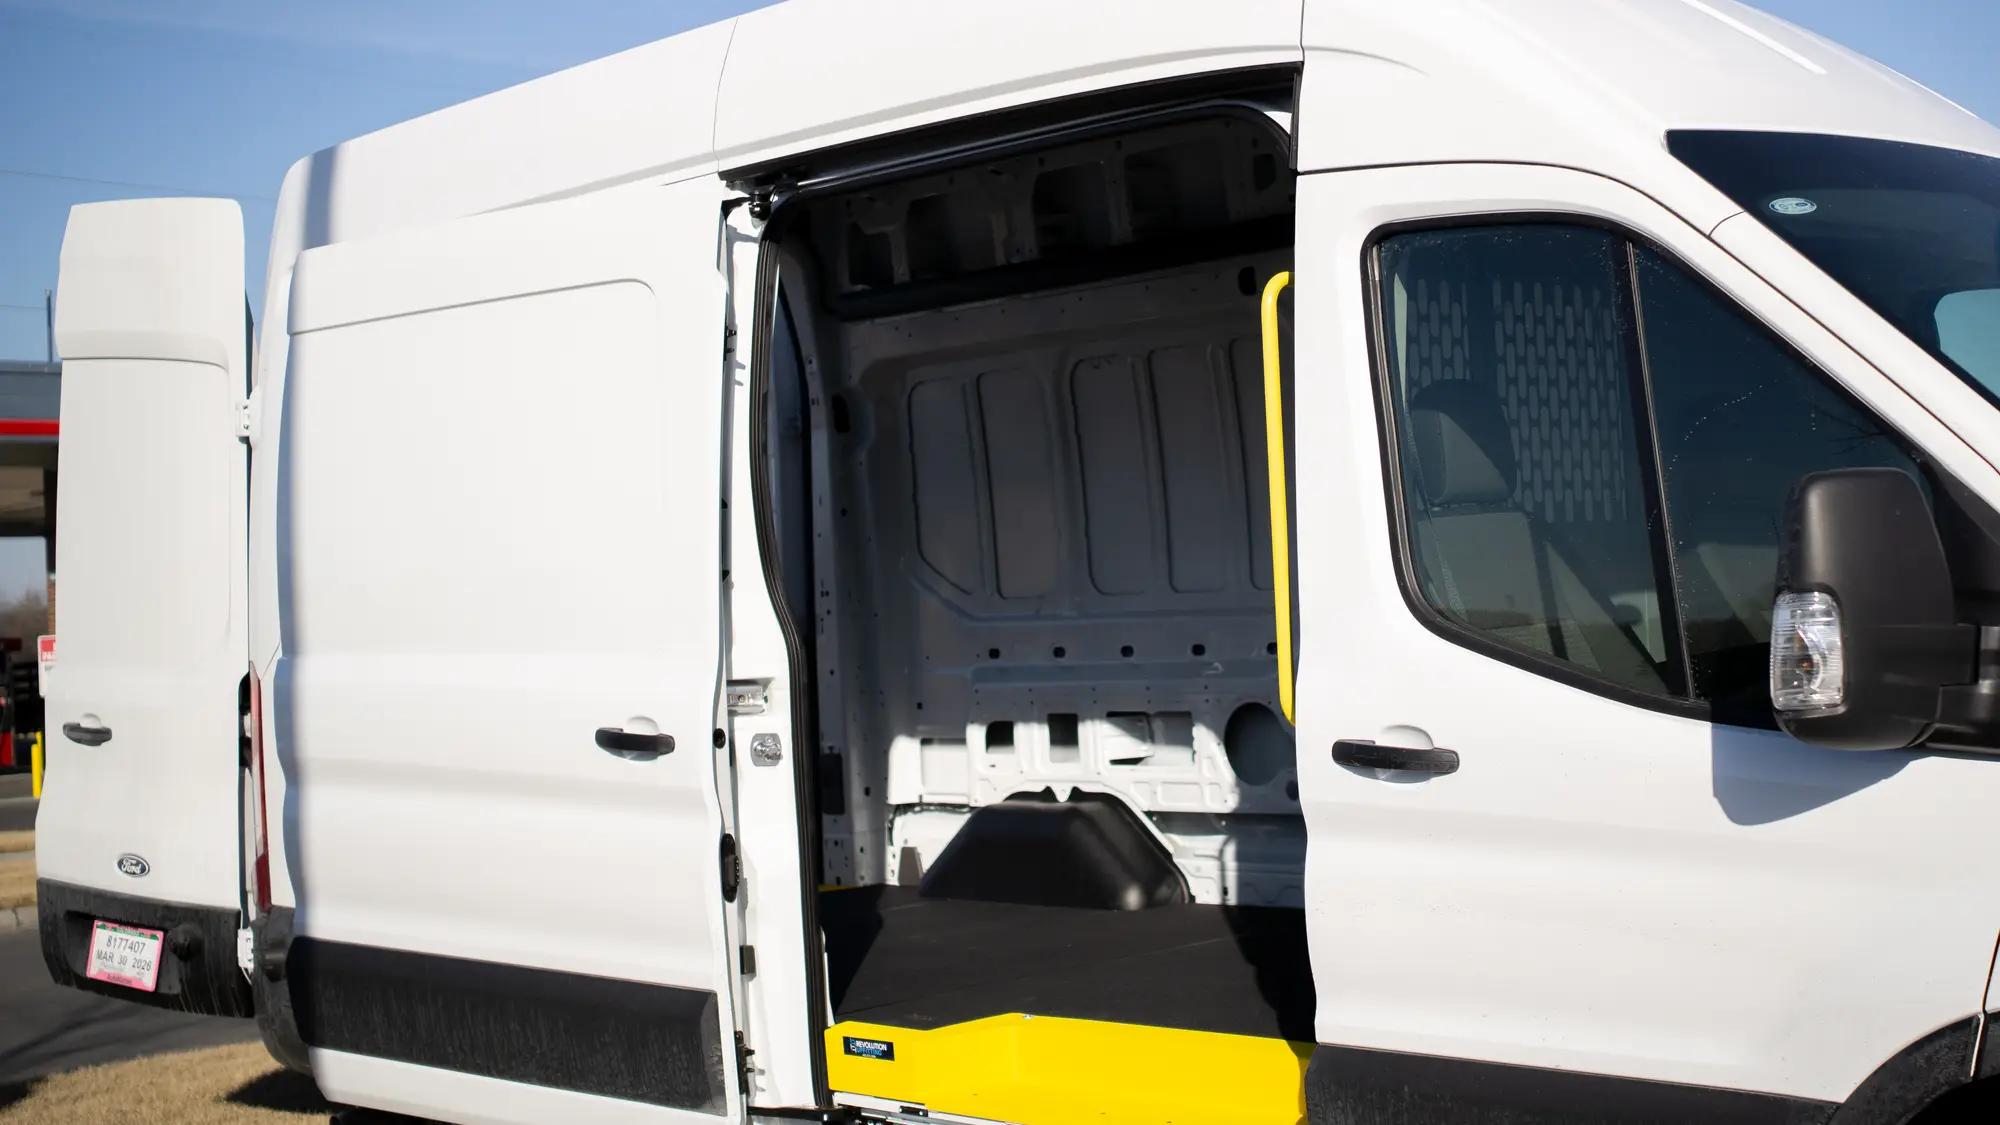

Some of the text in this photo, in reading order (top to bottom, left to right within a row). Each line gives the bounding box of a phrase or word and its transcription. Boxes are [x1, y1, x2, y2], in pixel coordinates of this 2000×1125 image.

[121, 857, 142, 874] Ford
[106, 935, 146, 955] 8177407
[96, 949, 115, 964] MAR
[117, 954, 128, 966] 30
[132, 957, 152, 972] 2026
[855, 1040, 887, 1051] REVOLUTION
[856, 1047, 882, 1056] UPFITTING
